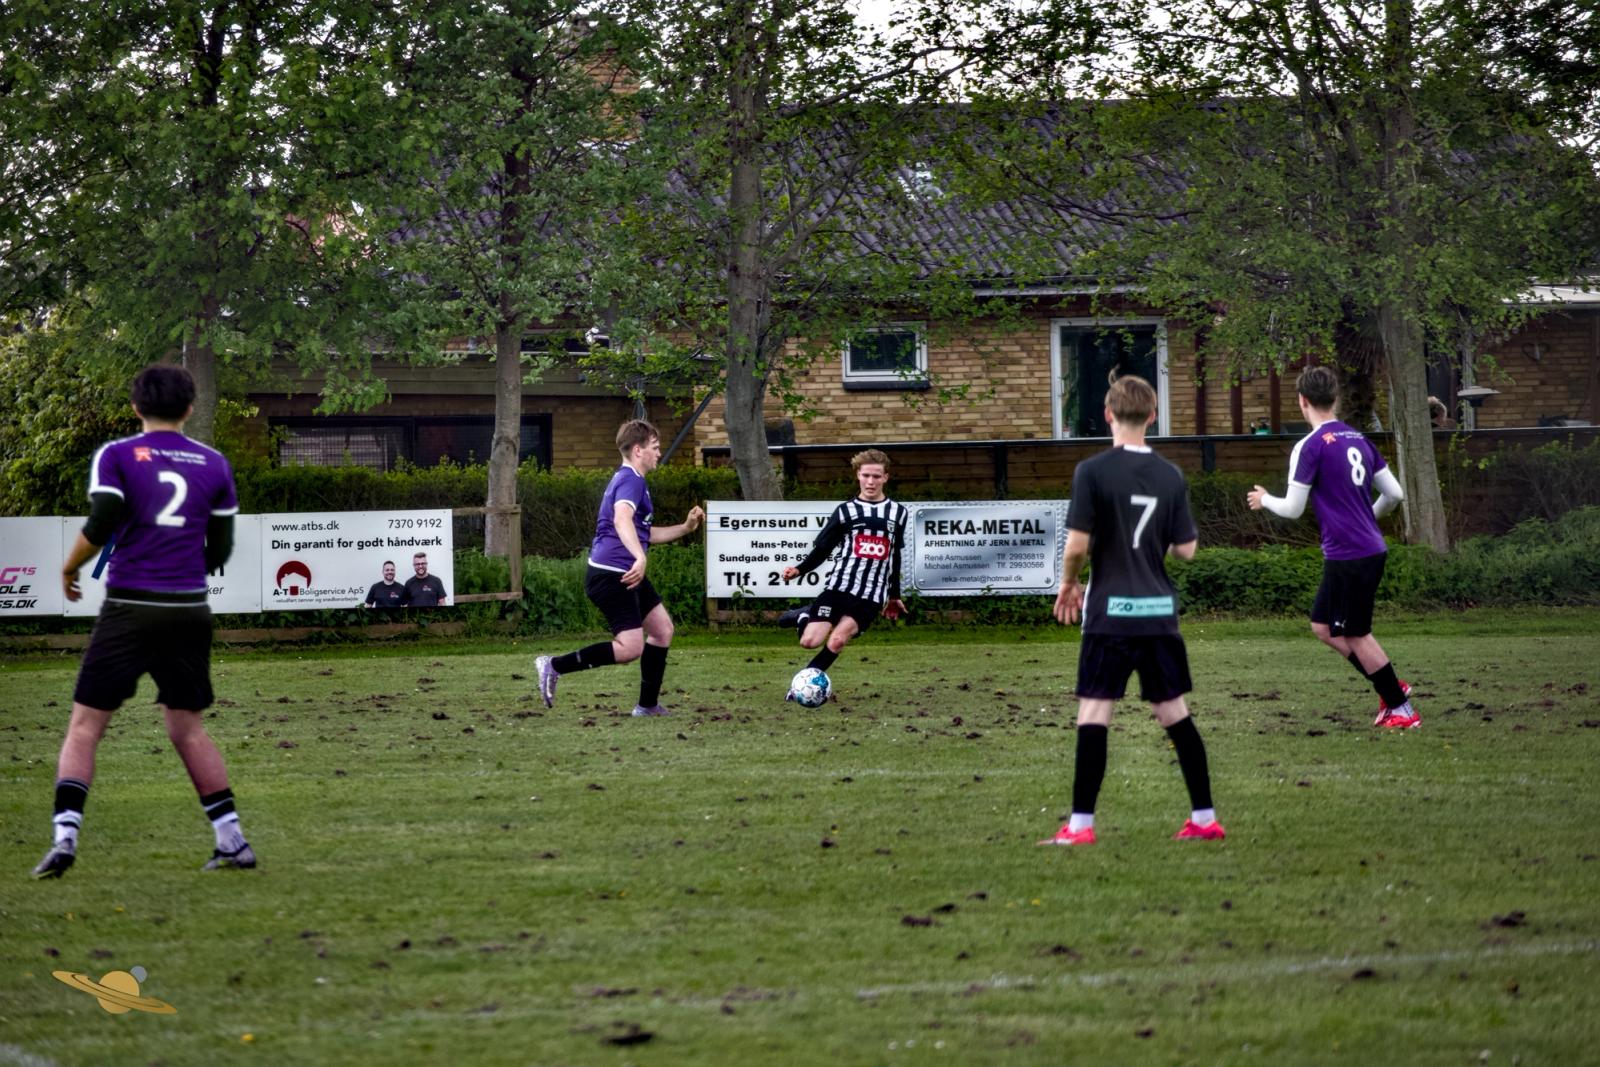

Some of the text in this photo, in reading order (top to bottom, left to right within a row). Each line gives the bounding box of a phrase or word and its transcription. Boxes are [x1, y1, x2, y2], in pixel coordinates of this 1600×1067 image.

[1347, 446, 1366, 486] 8
[156, 470, 188, 528] 2
[272, 518, 442, 531] www.atbs.dk 7370 9192
[720, 516, 808, 530] Egernsund
[924, 519, 1046, 535] REKA-METAL
[1130, 494, 1158, 549] 7
[271, 536, 442, 551] Din garanti for godt håndværk
[751, 541, 808, 549] Hans-Peter
[858, 542, 886, 557] ZOO
[719, 554, 769, 562] Sundgade
[774, 554, 788, 562] 98
[945, 553, 982, 561] Asmussen
[724, 572, 757, 586] Tlf.
[300, 588, 346, 597] Boligservice
[348, 587, 365, 595] ApS
